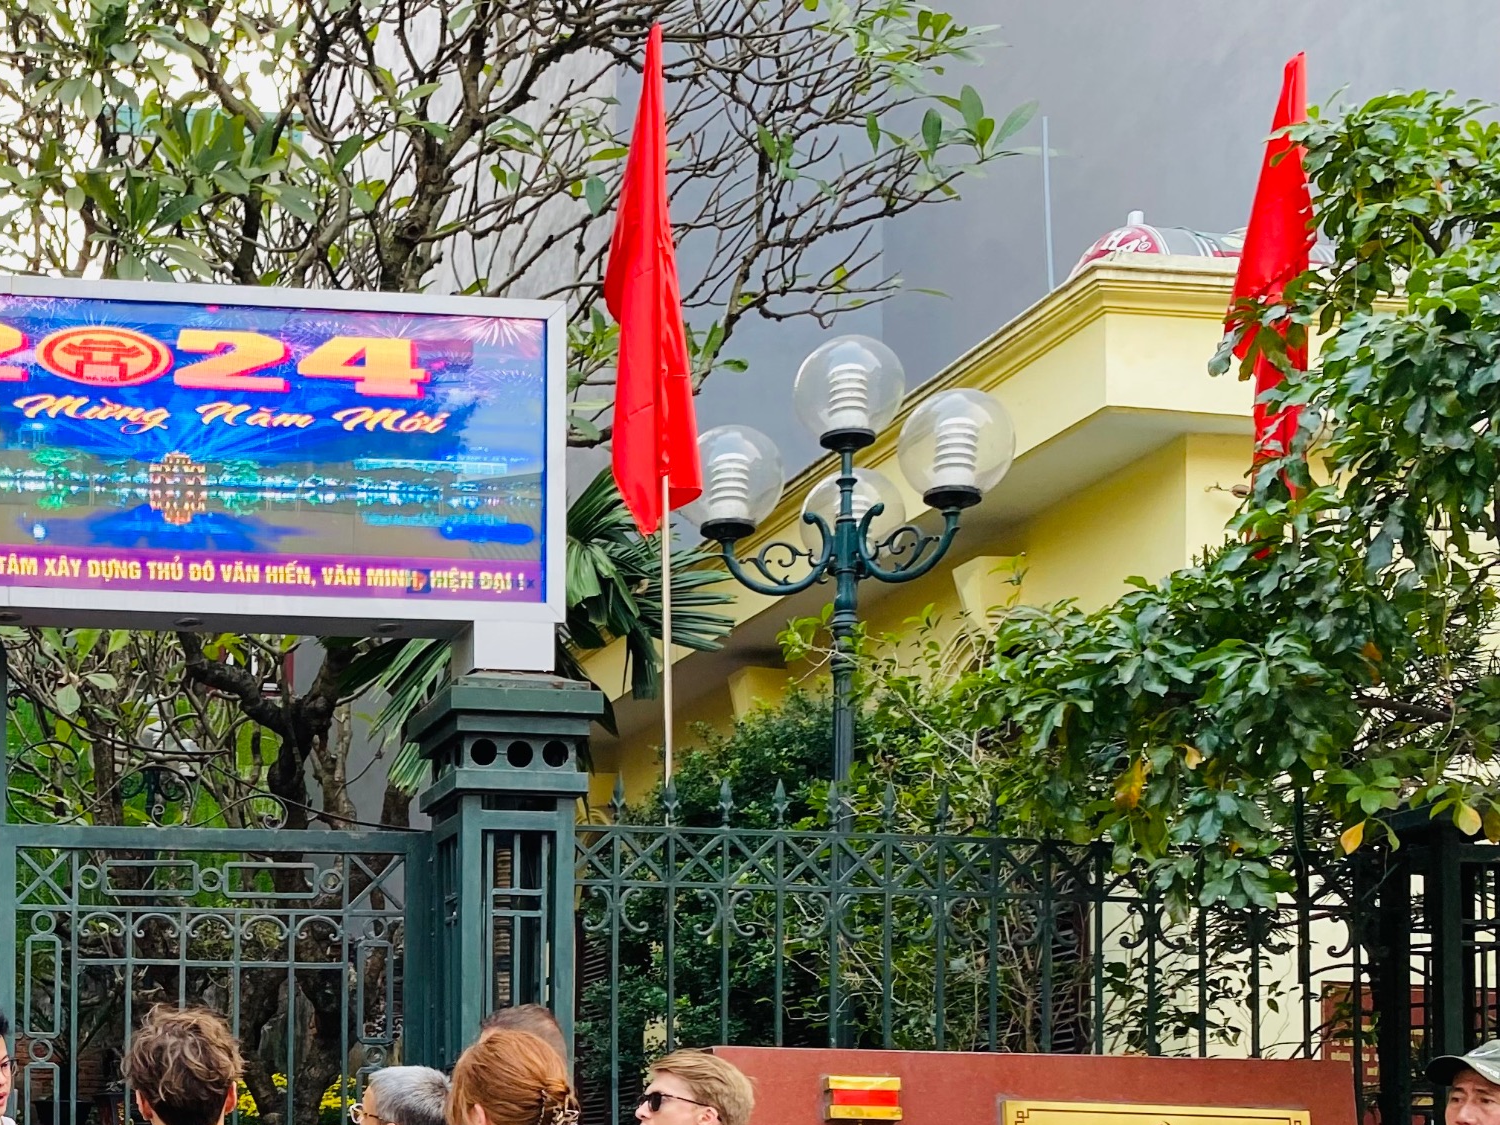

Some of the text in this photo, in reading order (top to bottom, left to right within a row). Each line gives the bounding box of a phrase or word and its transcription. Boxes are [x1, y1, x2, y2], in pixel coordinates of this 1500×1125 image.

[14, 391, 175, 435] Mừng
[195, 400, 316, 430] Năm
[332, 402, 451, 436] Mới
[44, 555, 82, 578] XÂY
[146, 555, 184, 581] THỦ
[189, 558, 215, 582] ĐÔ
[220, 559, 259, 583] VĂN
[321, 564, 361, 587] VĂN
